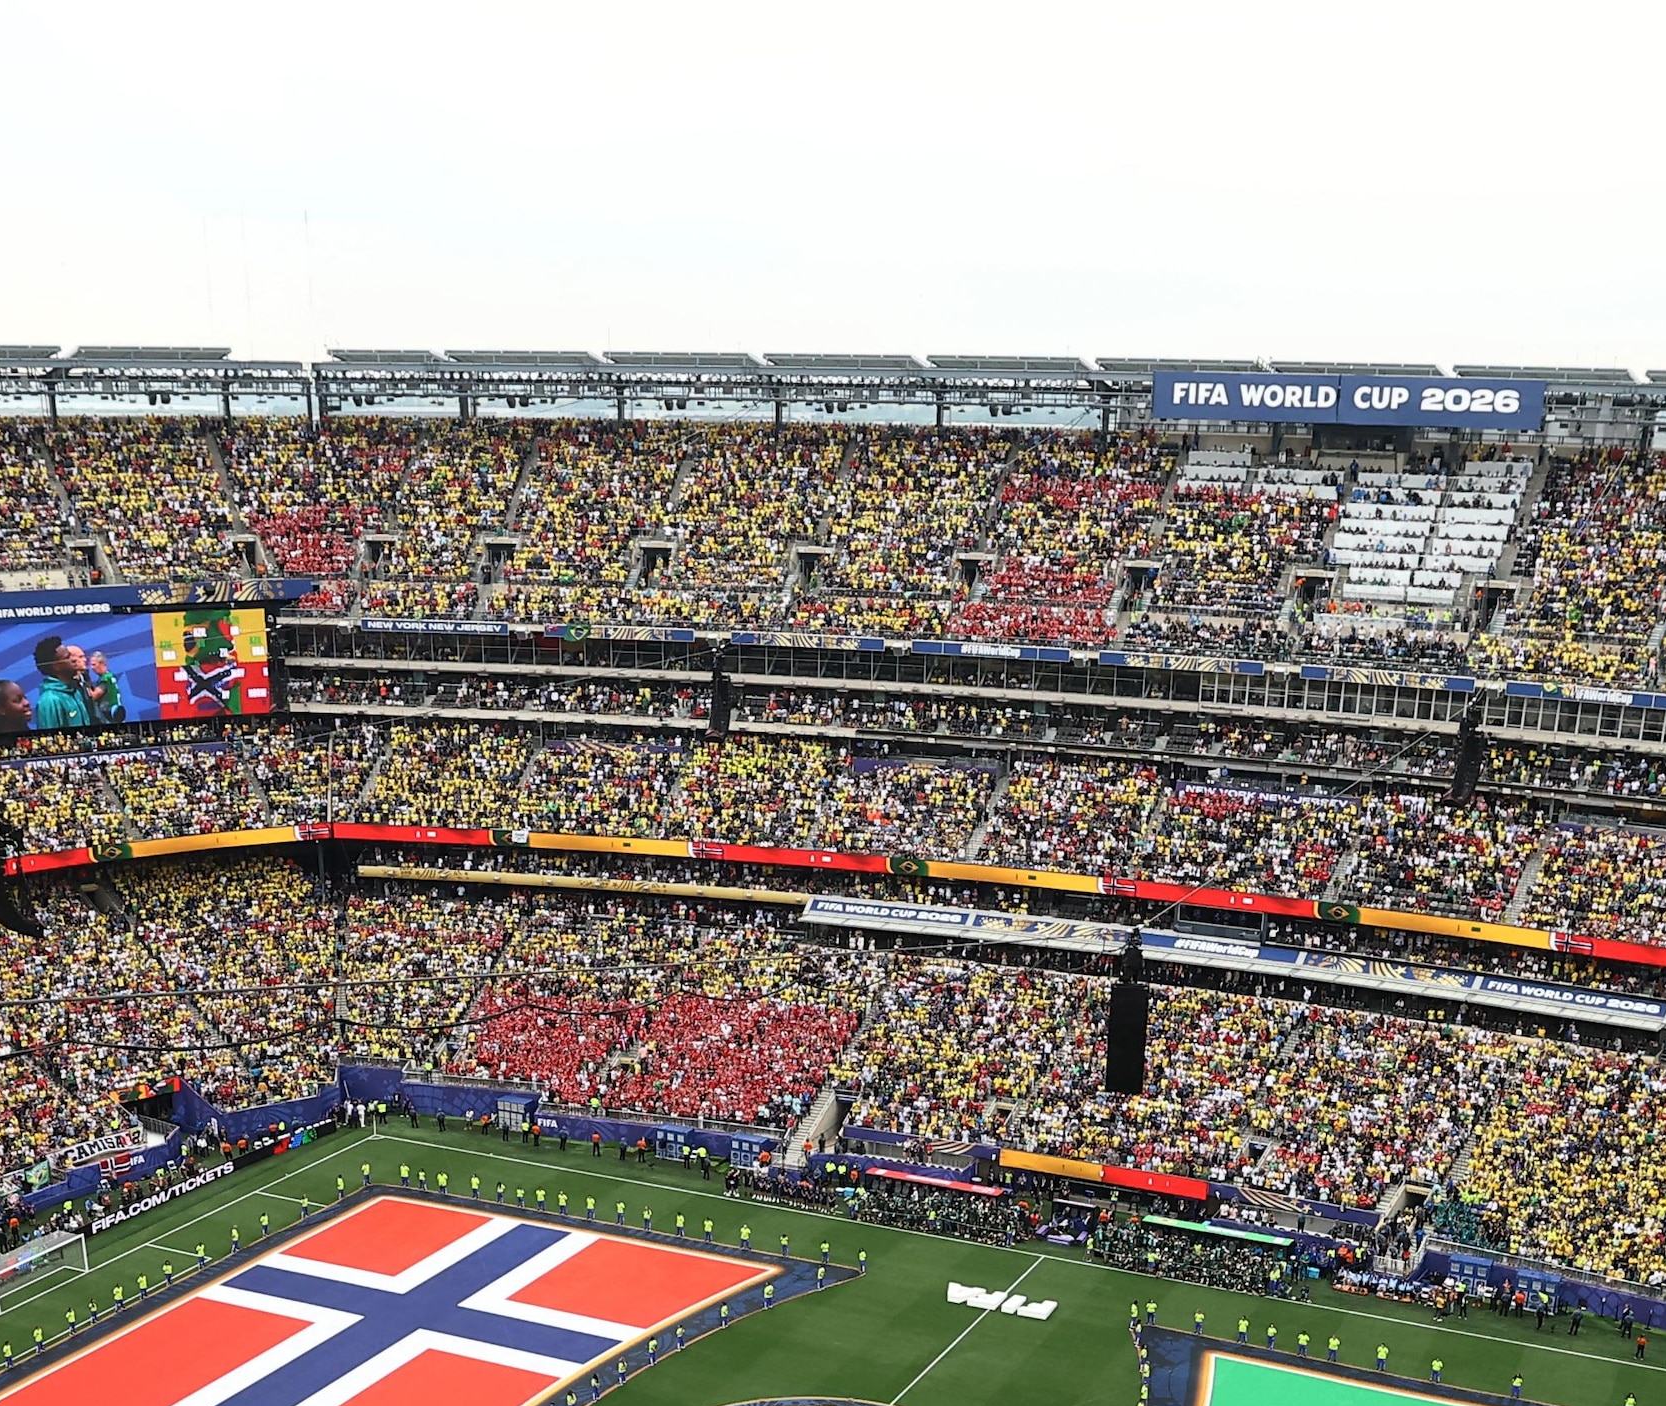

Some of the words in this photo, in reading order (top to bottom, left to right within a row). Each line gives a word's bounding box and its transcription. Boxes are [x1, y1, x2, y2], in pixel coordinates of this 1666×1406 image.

[1173, 382, 1229, 406] FIFA
[1240, 384, 1337, 408] WORLD
[1353, 386, 1409, 409] CUP
[1420, 388, 1520, 413] 2026
[15, 606, 53, 618] WORLD
[53, 605, 74, 616] CUP
[75, 603, 111, 614] 2026
[367, 620, 393, 630] NEW
[396, 621, 426, 630] YORK
[428, 622, 455, 631] NEW
[456, 623, 502, 633] JERSEY
[961, 643, 1021, 659] #FIFAWorldCup
[1259, 792, 1292, 804] NEW
[816, 901, 844, 912] FIFA
[845, 904, 889, 917] WORLD
[890, 908, 917, 919] CUP
[916, 911, 962, 923] 2026
[1174, 939, 1260, 959] #FIFAWorldCup
[1487, 981, 1518, 993] FIFA
[1521, 985, 1573, 1001] WORLD
[1575, 993, 1606, 1006] CUP
[1606, 998, 1661, 1014] 2026
[537, 1118, 558, 1128] FIFA
[64, 1134, 125, 1163] CAMISA
[129, 1154, 145, 1167] IFA
[91, 1161, 234, 1235] FIFA.COM/TICKETS
